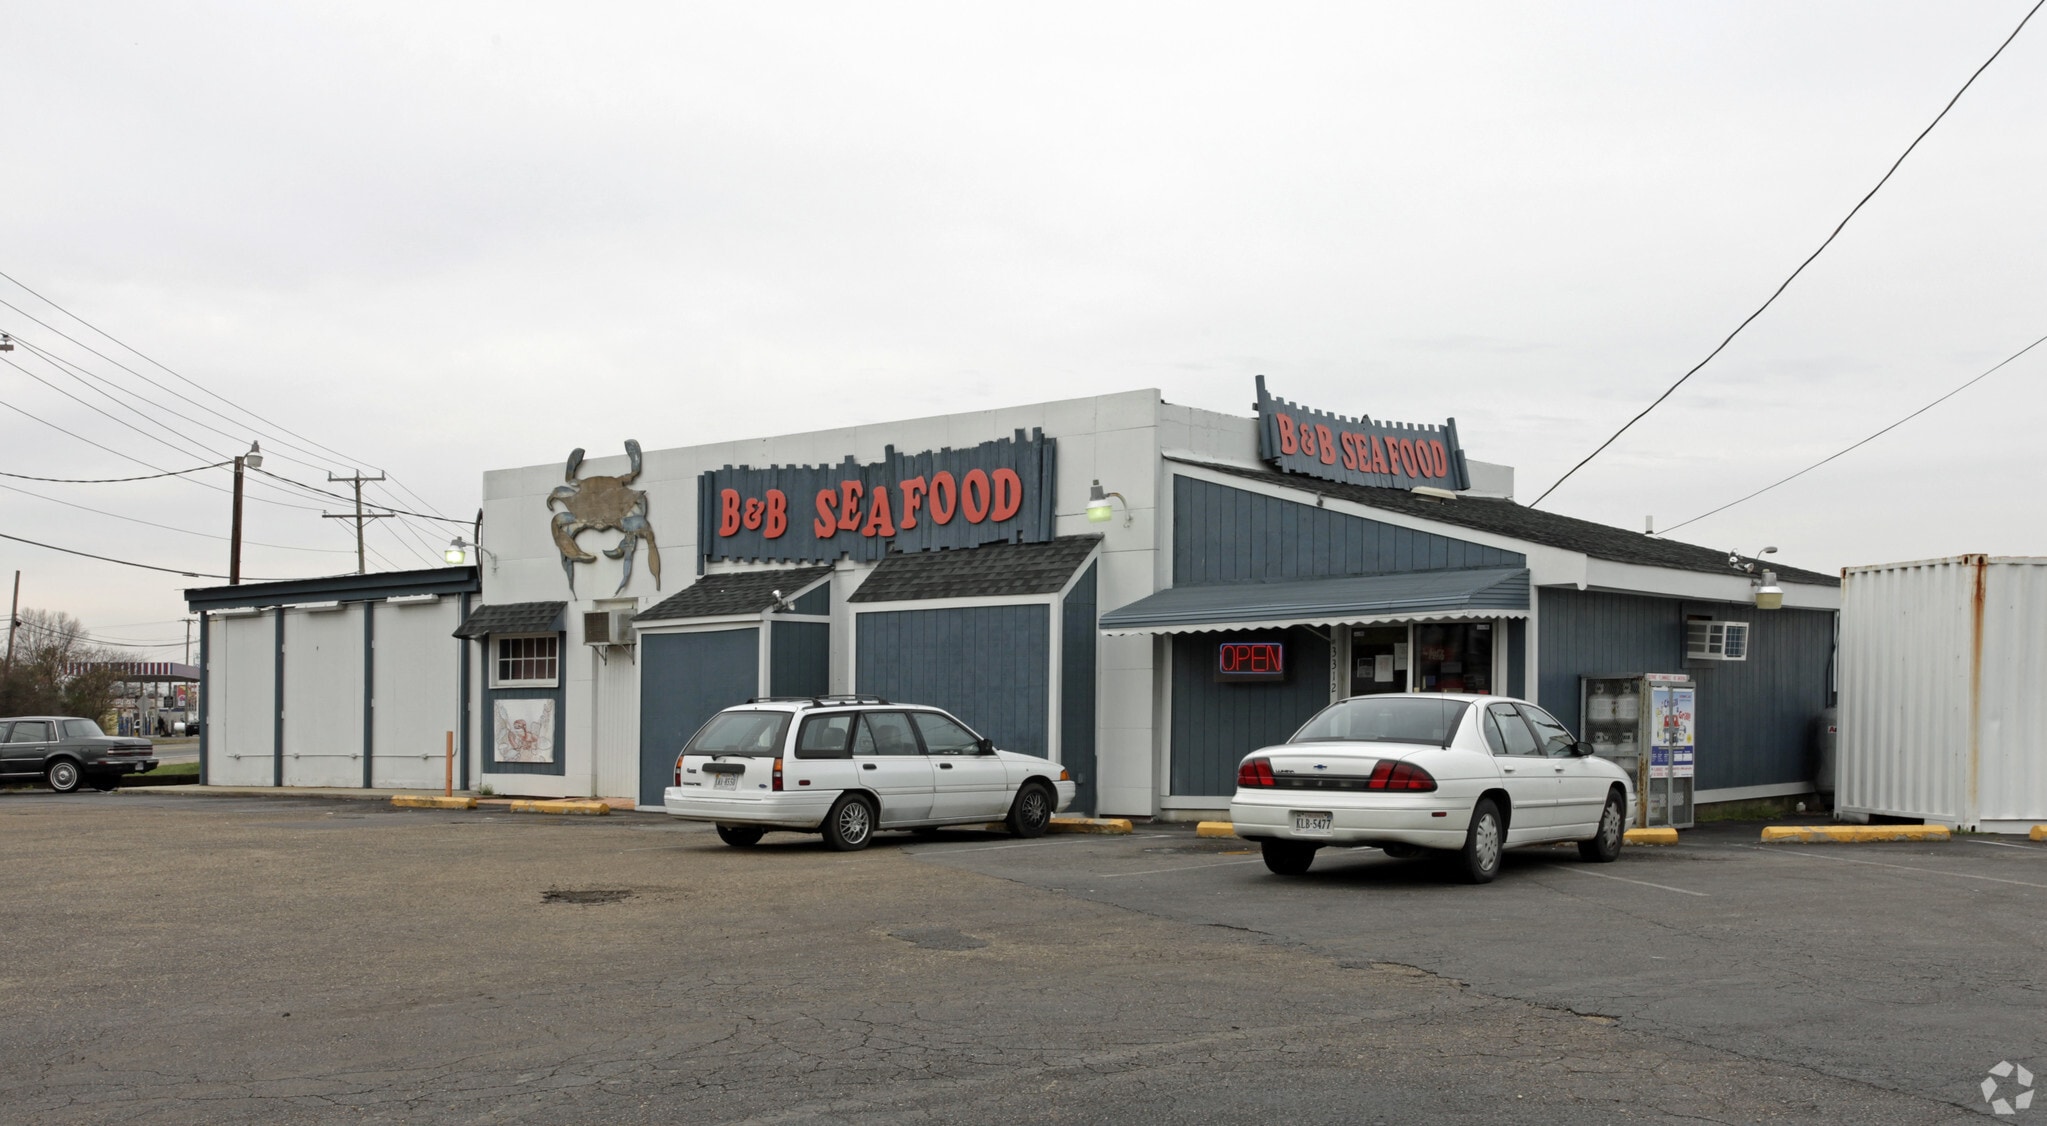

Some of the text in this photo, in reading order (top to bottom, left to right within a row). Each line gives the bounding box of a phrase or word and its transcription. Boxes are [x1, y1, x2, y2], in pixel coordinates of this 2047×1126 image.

[1276, 413, 1447, 478] B&B SEAFOOD
[719, 468, 1022, 539] B&B SEAFOOD
[1221, 645, 1282, 671] OPEN
